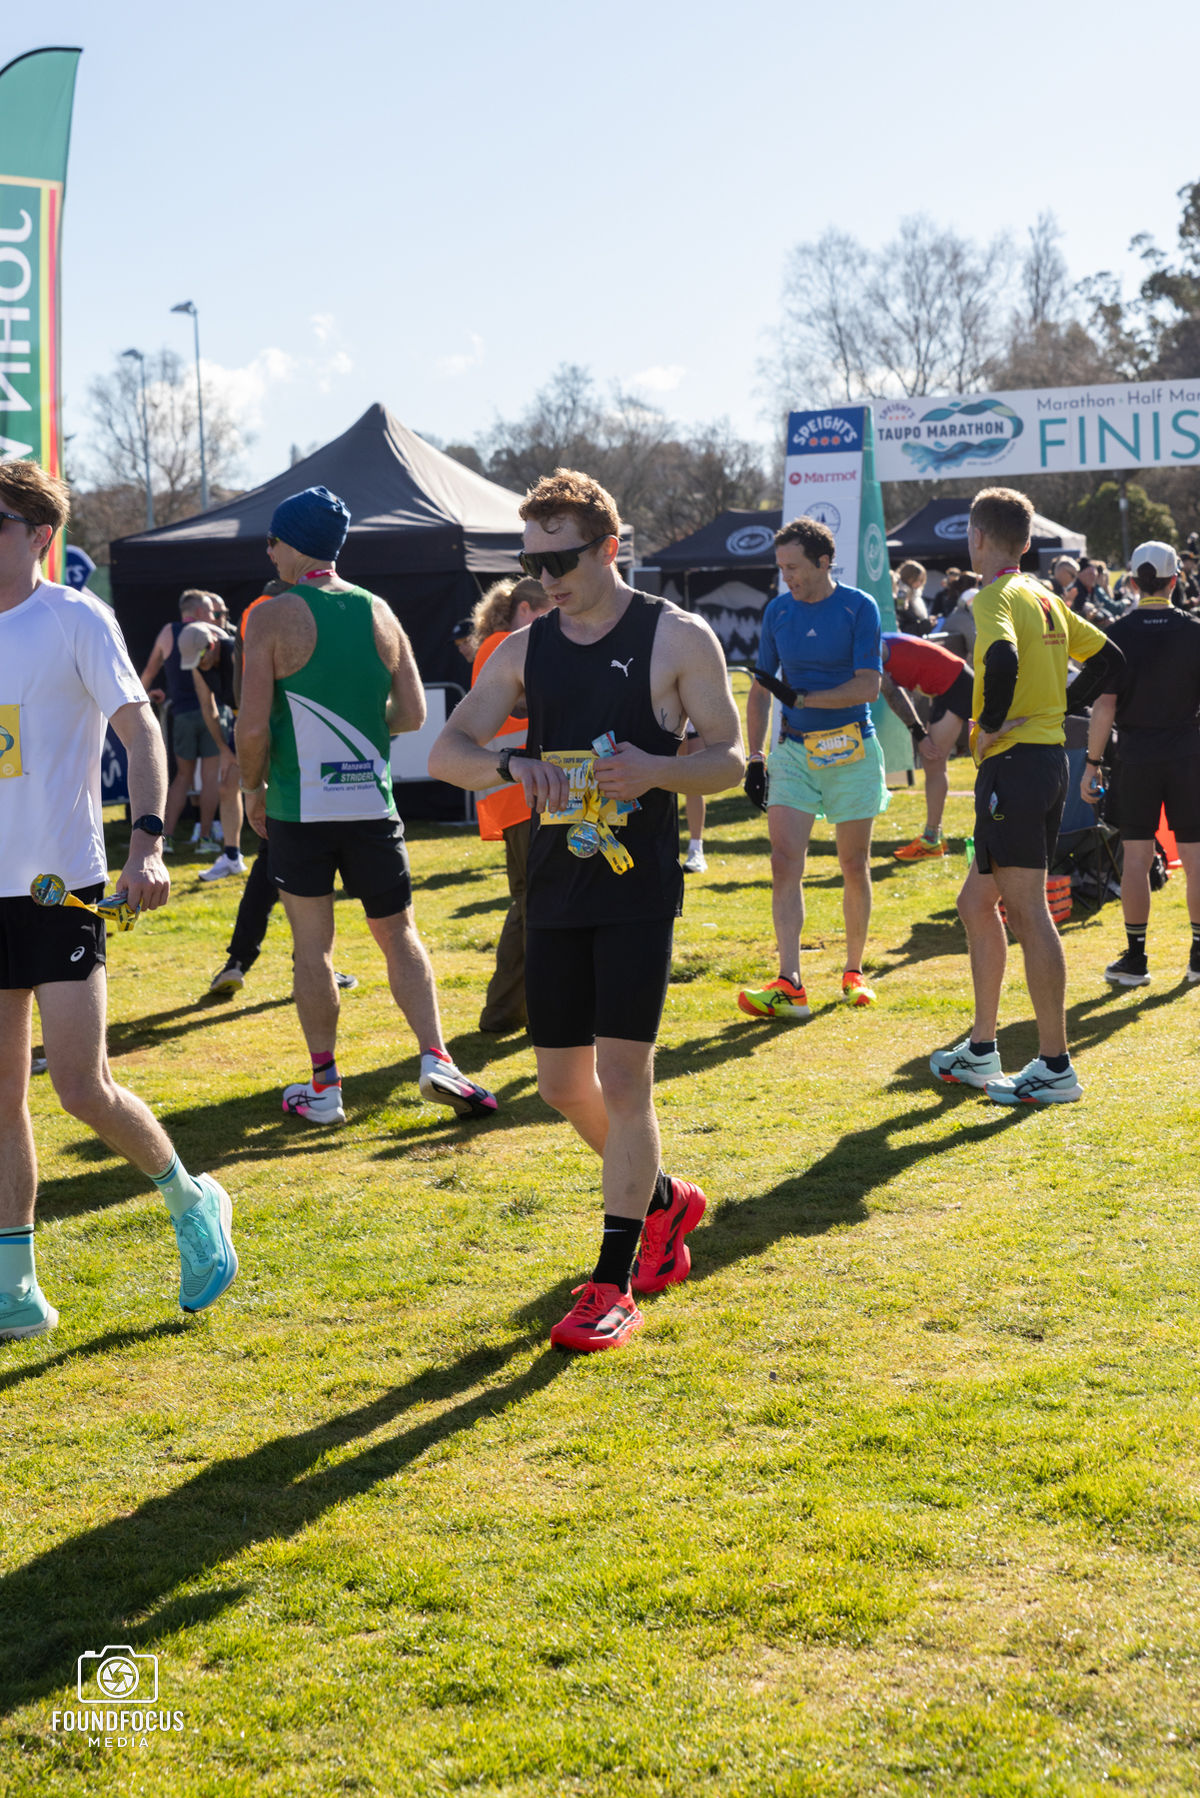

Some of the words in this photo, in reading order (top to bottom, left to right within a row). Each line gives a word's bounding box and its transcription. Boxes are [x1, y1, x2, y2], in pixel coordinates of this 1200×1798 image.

[1036, 392, 1115, 412] Marathon
[1127, 388, 1163, 405] Half
[877, 426, 921, 442] TAUPO
[926, 421, 1005, 439] MARATHON
[1039, 409, 1200, 468] FINIS
[803, 469, 858, 485] Marmot
[340, 771, 375, 783] STRIDERS
